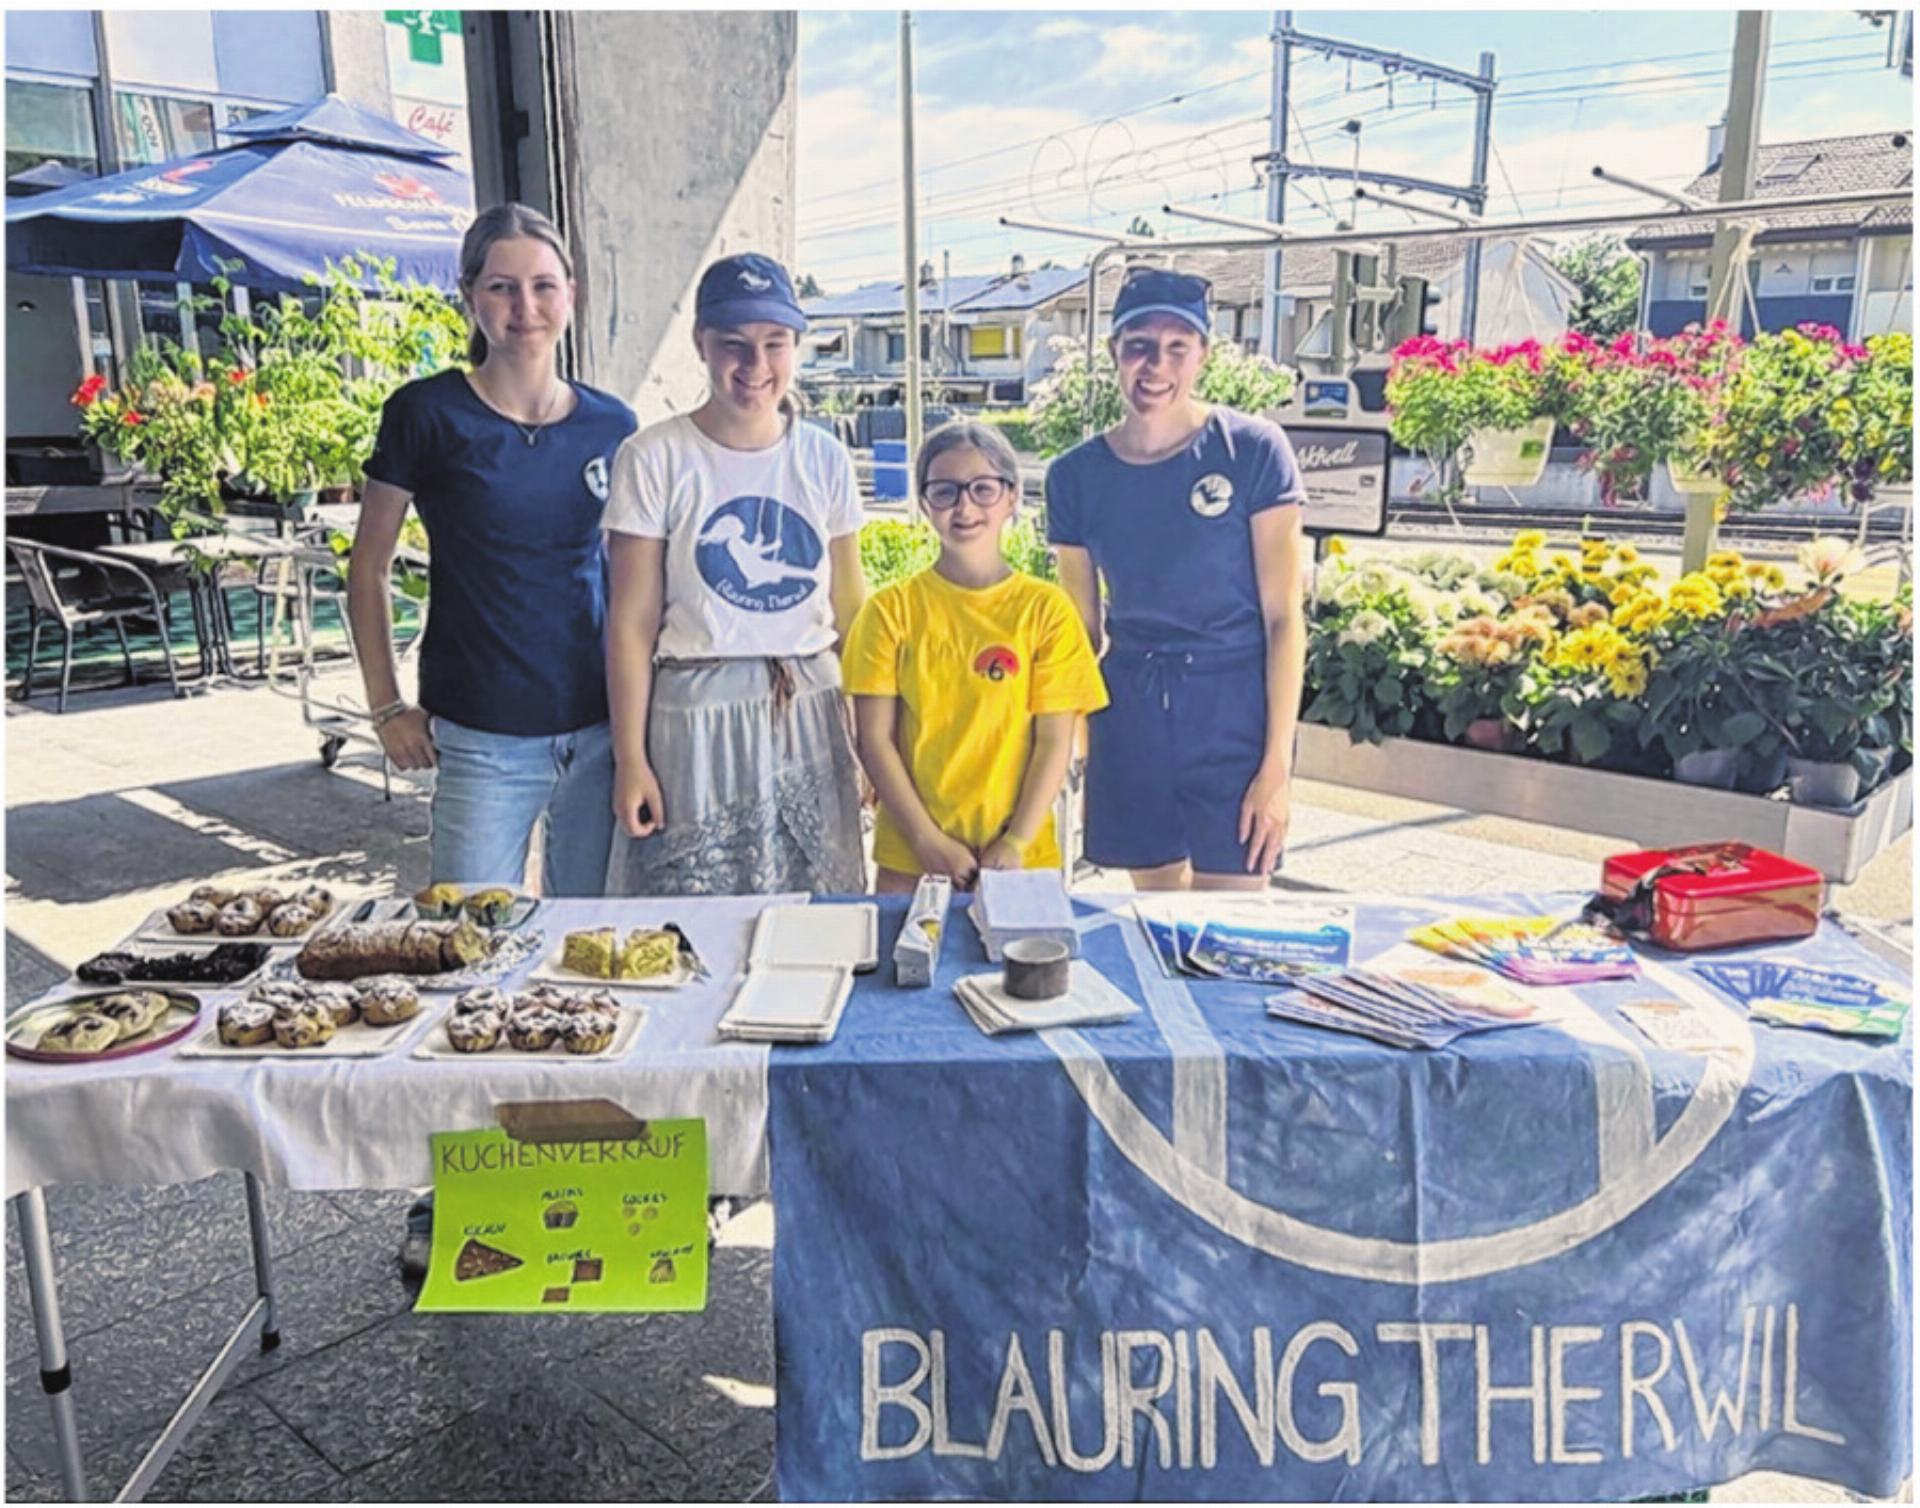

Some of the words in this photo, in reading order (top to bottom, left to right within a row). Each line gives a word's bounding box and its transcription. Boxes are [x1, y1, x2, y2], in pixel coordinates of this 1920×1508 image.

[408, 105, 455, 139] Café
[988, 657, 1005, 682] 6
[441, 1132, 687, 1175] KUCHENVERKAUF
[860, 1321, 1362, 1473] BLAURING
[1374, 1303, 1846, 1467] THERWIL
